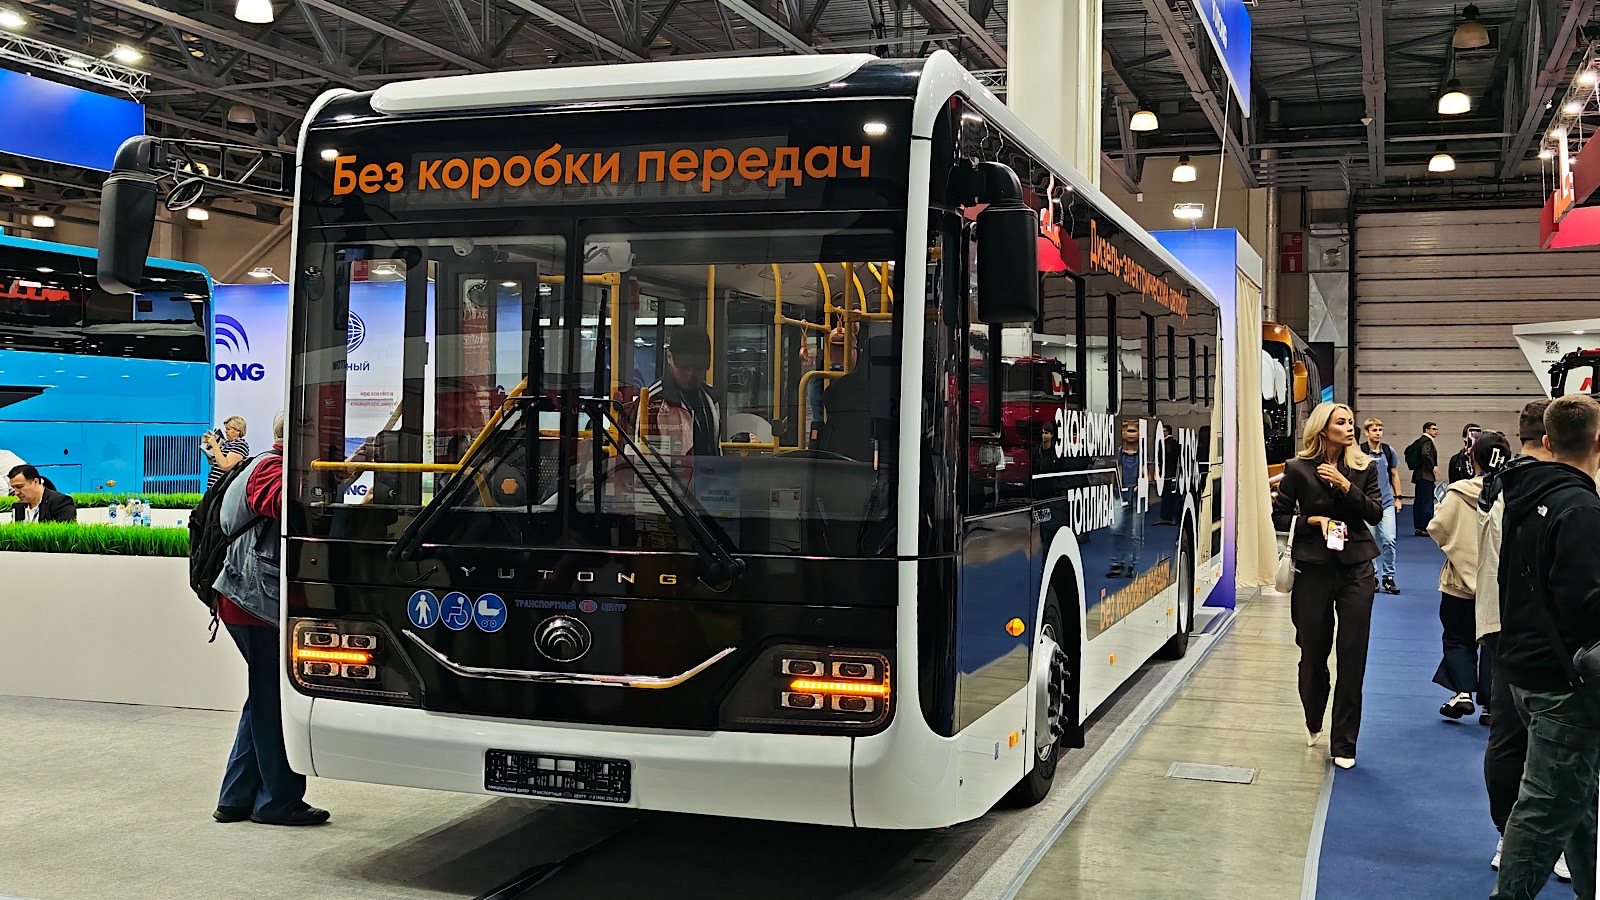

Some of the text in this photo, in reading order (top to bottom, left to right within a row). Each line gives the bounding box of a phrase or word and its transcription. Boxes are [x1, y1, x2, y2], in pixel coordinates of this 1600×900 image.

[333, 143, 871, 199] Без коробки передач
[1090, 219, 1169, 309] Дизель-электрический
[1055, 408, 1115, 458] ЭКОНОМИЯ
[1178, 427, 1200, 495] 30%
[344, 485, 368, 496] NG
[1067, 484, 1115, 536] ТОПЛИВА
[460, 566, 677, 585] YUTONG
[515, 599, 577, 610] ТРАНСПОРТНЫЙ
[601, 603, 627, 612] ЦЕНТР
[1099, 588, 1115, 631] Без
